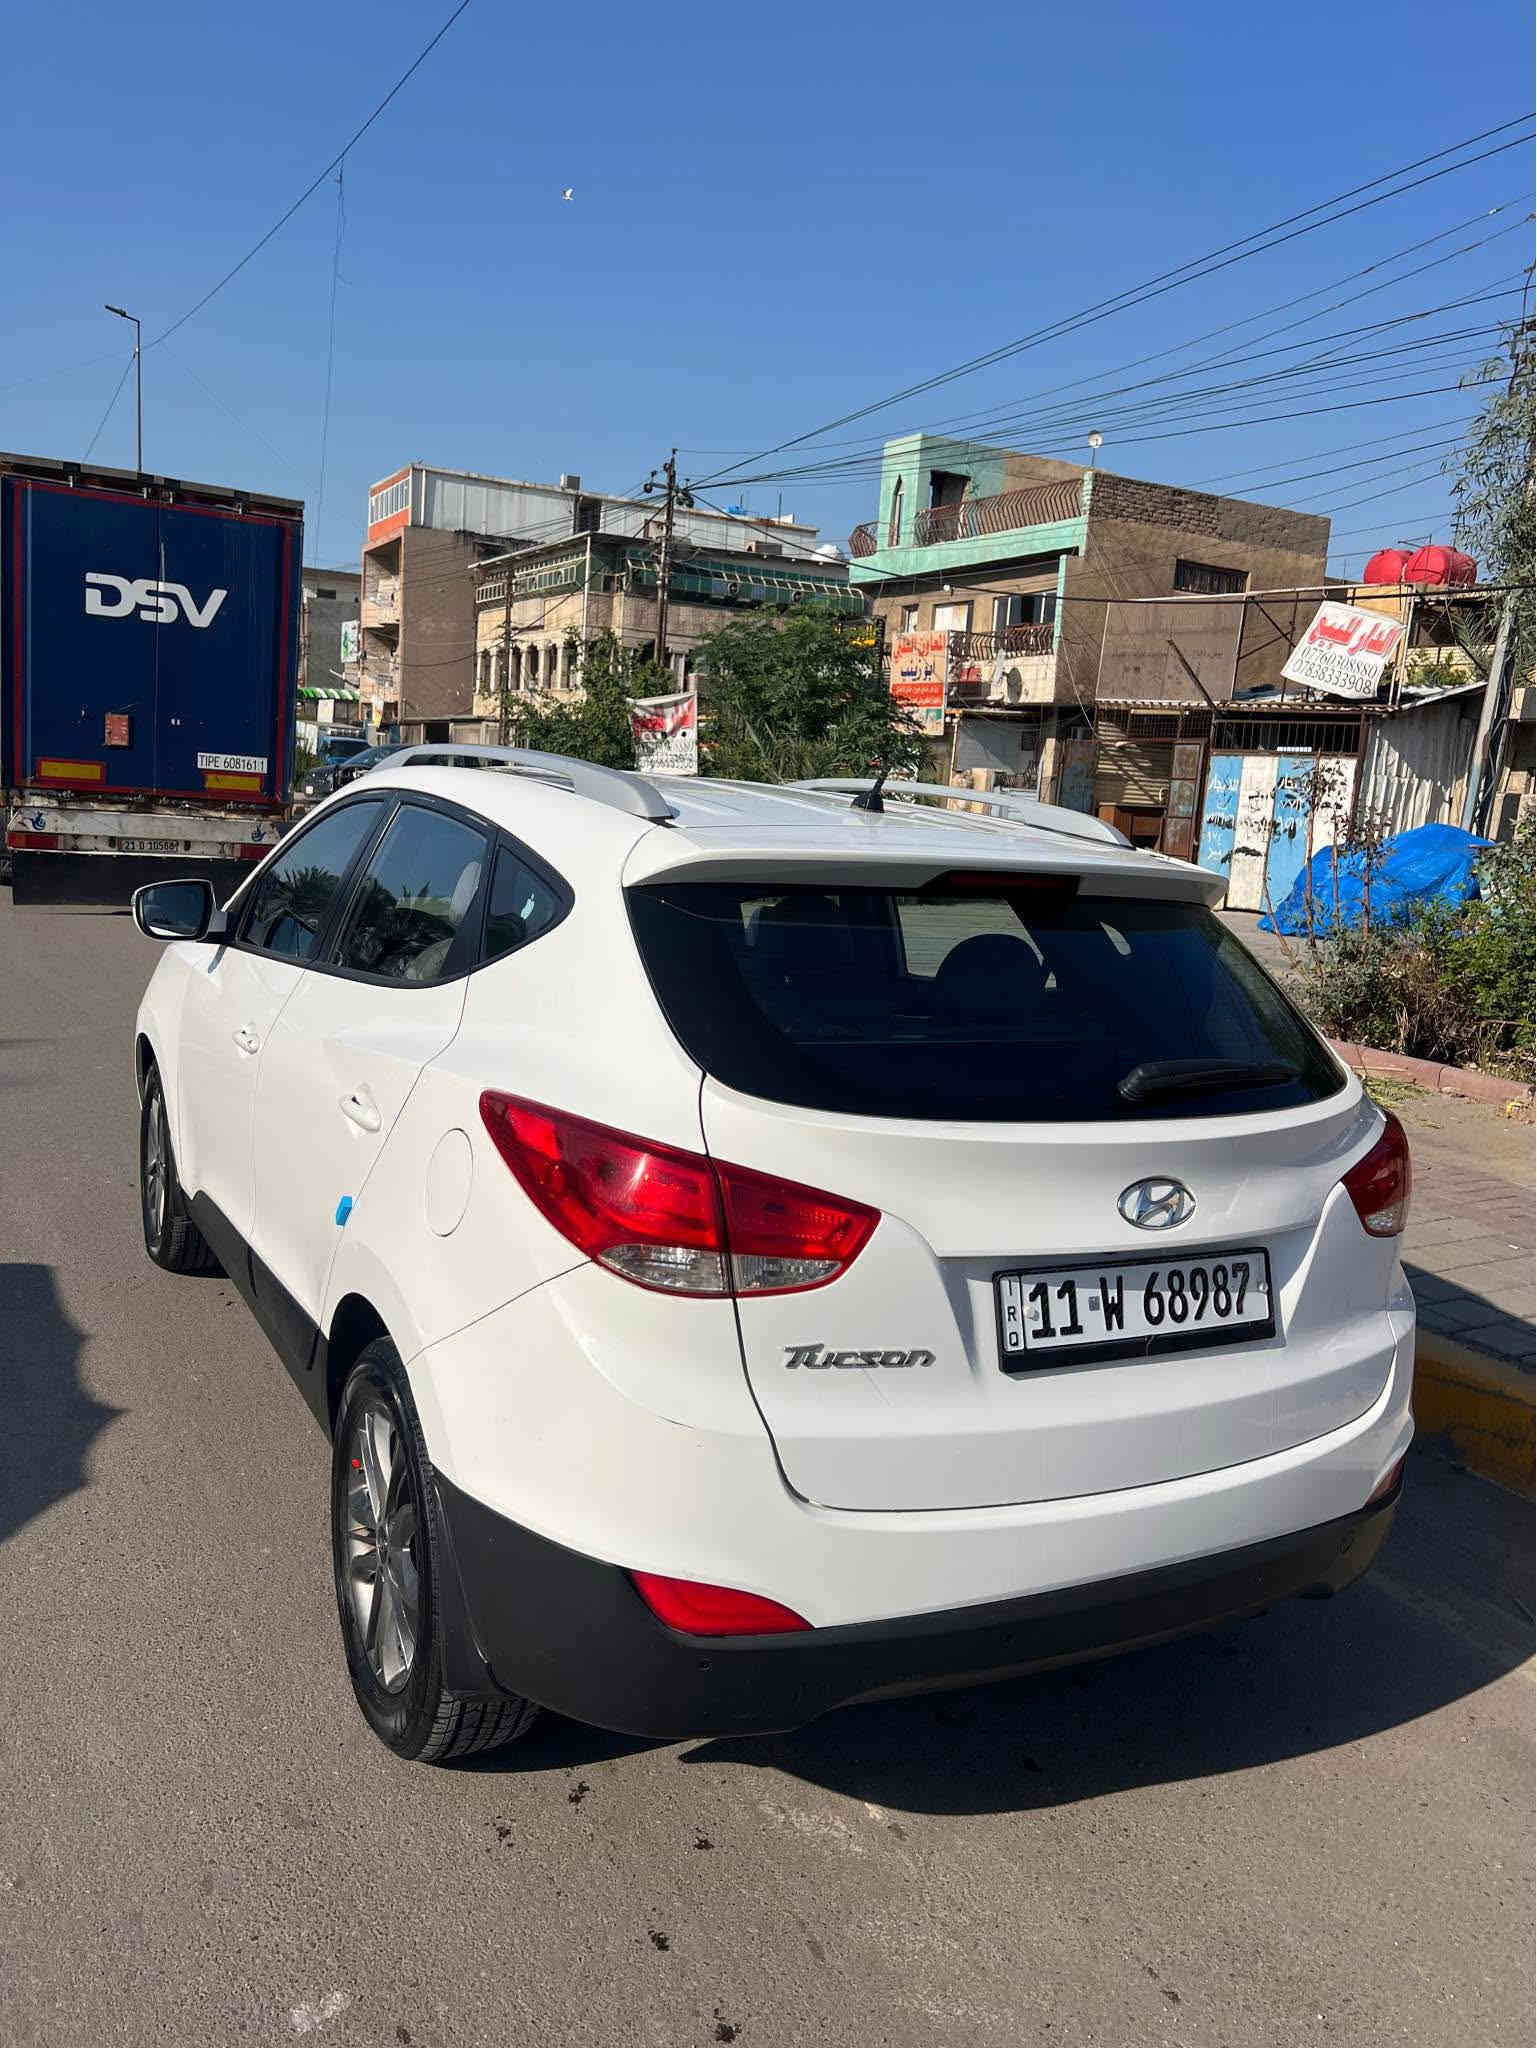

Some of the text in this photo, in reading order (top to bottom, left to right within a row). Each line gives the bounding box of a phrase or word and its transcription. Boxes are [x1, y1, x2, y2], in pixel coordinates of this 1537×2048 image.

[85, 572, 228, 628] DSV
[1307, 617, 1397, 656] الدار للبيع
[199, 755, 221, 768] TIPE
[125, 841, 135, 850] 21
[1028, 1262, 1250, 1339] 11 W 68987
[784, 1343, 936, 1369] Tucson
